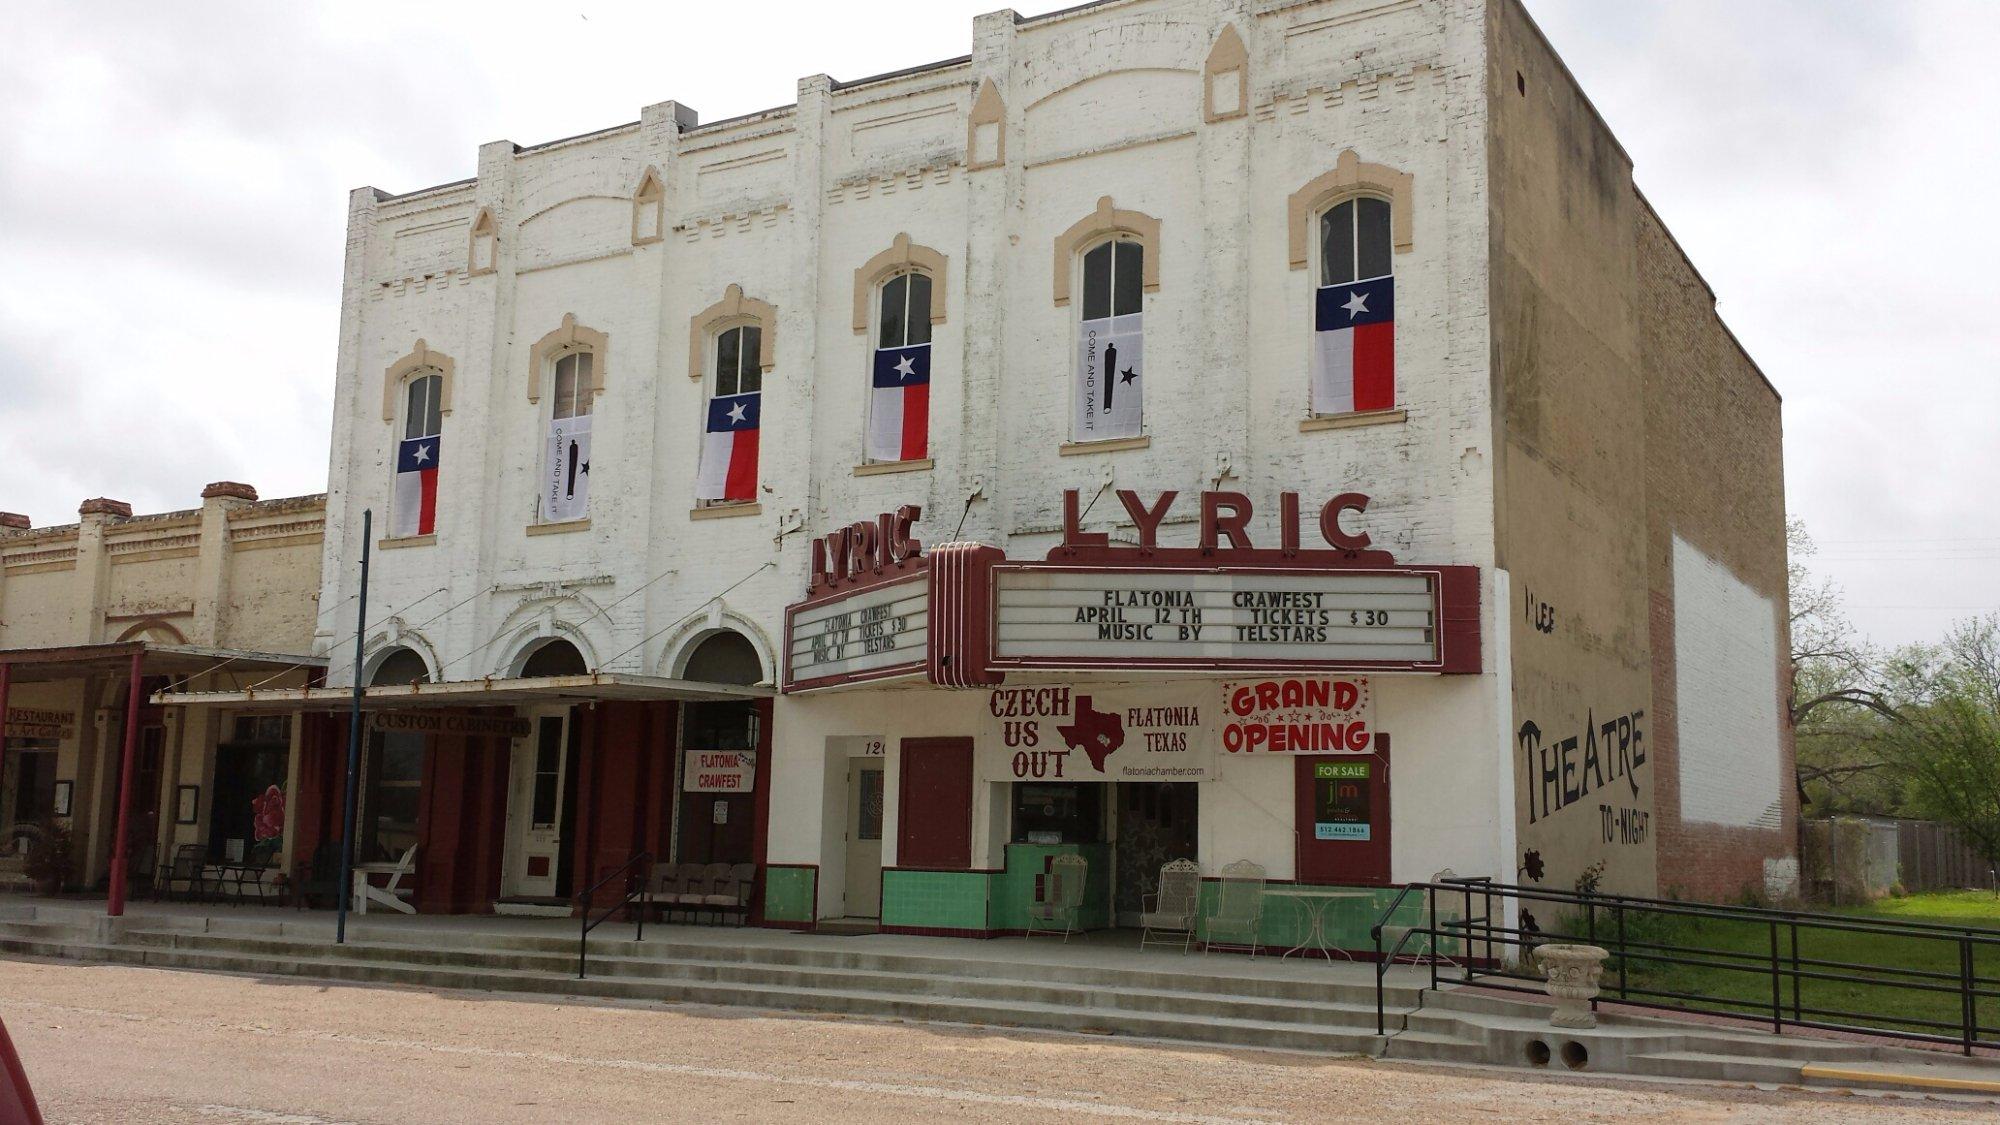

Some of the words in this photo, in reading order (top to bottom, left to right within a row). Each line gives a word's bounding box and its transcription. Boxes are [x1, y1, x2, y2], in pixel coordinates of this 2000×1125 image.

[1088, 330, 1097, 362] COME
[1086, 365, 1095, 388] AND
[1086, 391, 1095, 419] TAKE
[1085, 421, 1094, 431] IT
[555, 428, 563, 455] COME
[553, 458, 562, 477] AND
[552, 480, 560, 503] TAKE
[1063, 489, 1372, 550] LYRIC
[810, 504, 922, 587] LYRIC
[1104, 591, 1194, 608] FLATONIA
[1233, 591, 1323, 608] CRAWFEST
[825, 613, 852, 633] FLATONIA
[860, 604, 892, 624] CRAWFEST
[1075, 607, 1127, 624] APRIL
[1155, 608, 1171, 623] 12
[1179, 609, 1201, 624] TH
[1251, 610, 1330, 626] TICKETS
[811, 635, 826, 651] APRIL
[859, 621, 884, 640] TICKETS
[1099, 624, 1153, 640] MUSIC
[1178, 625, 1201, 641] BY
[1236, 626, 1327, 643] TELSTARS
[837, 643, 846, 660] BY
[864, 635, 896, 655] TELSTARS
[990, 687, 1071, 718] CZECH
[1231, 679, 1359, 717] GRAND
[376, 712, 441, 730] CUSTOM
[1128, 706, 1200, 728] FLATONIA
[1004, 721, 1039, 747] US
[1144, 732, 1187, 752] TEXAS
[1223, 721, 1370, 753] OPENING
[700, 754, 740, 768] FLATONIA
[1012, 750, 1070, 778] OUT
[1122, 766, 1204, 776] flatoniachamber.com
[1319, 766, 1339, 776] FOR
[1341, 766, 1365, 776] SALE
[1518, 706, 1646, 825] THEATRE
[698, 773, 742, 788] CRAWFEST
[1600, 804, 1649, 845] TO-NIGHT
